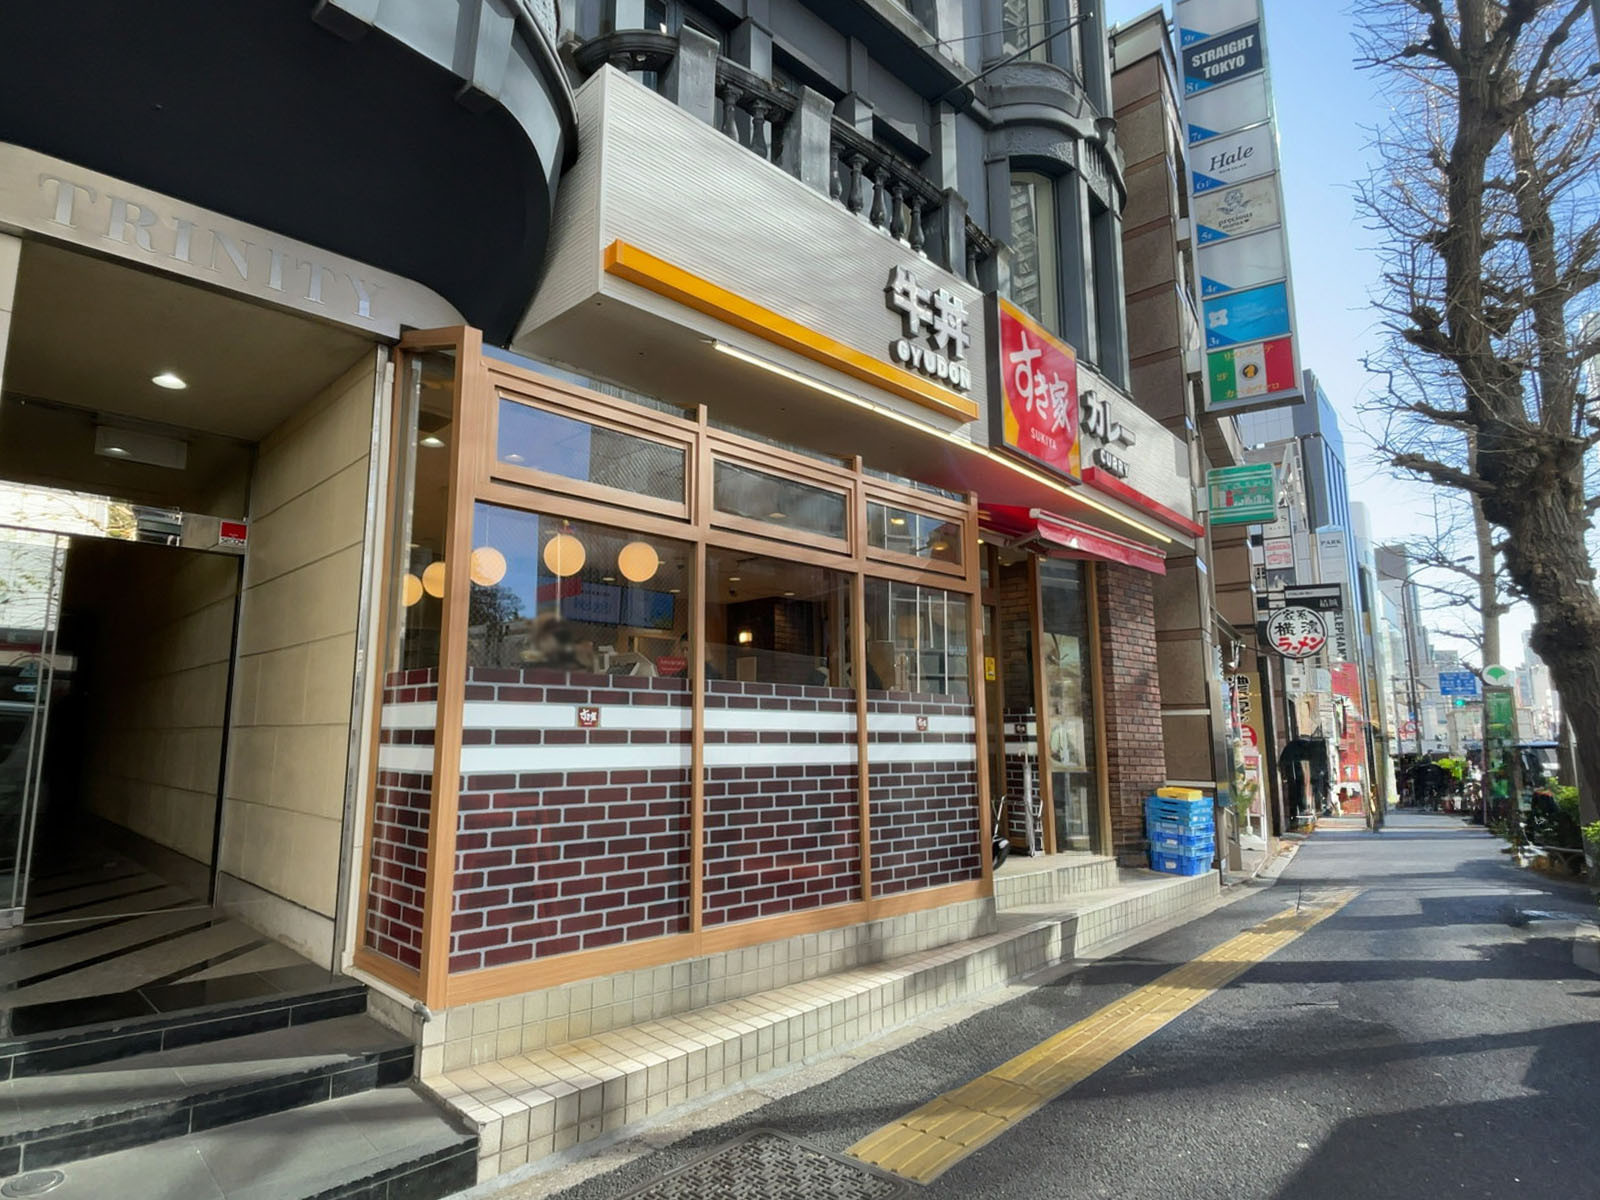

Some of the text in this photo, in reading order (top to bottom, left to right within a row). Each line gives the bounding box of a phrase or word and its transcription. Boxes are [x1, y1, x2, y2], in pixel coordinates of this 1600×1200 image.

[1191, 34, 1254, 67] STRAIGHT
[1203, 55, 1245, 79] TOKYO
[1209, 145, 1253, 172] Hale
[39, 172, 384, 320] TRINITY
[888, 264, 970, 358] 牛丼
[892, 340, 971, 391] GYUDON
[1009, 330, 1071, 433] すき家
[1081, 390, 1136, 446] カレー
[1030, 427, 1058, 450] SUKIYA
[1096, 448, 1129, 479] CURRY
[1278, 636, 1324, 655] ラーメン
